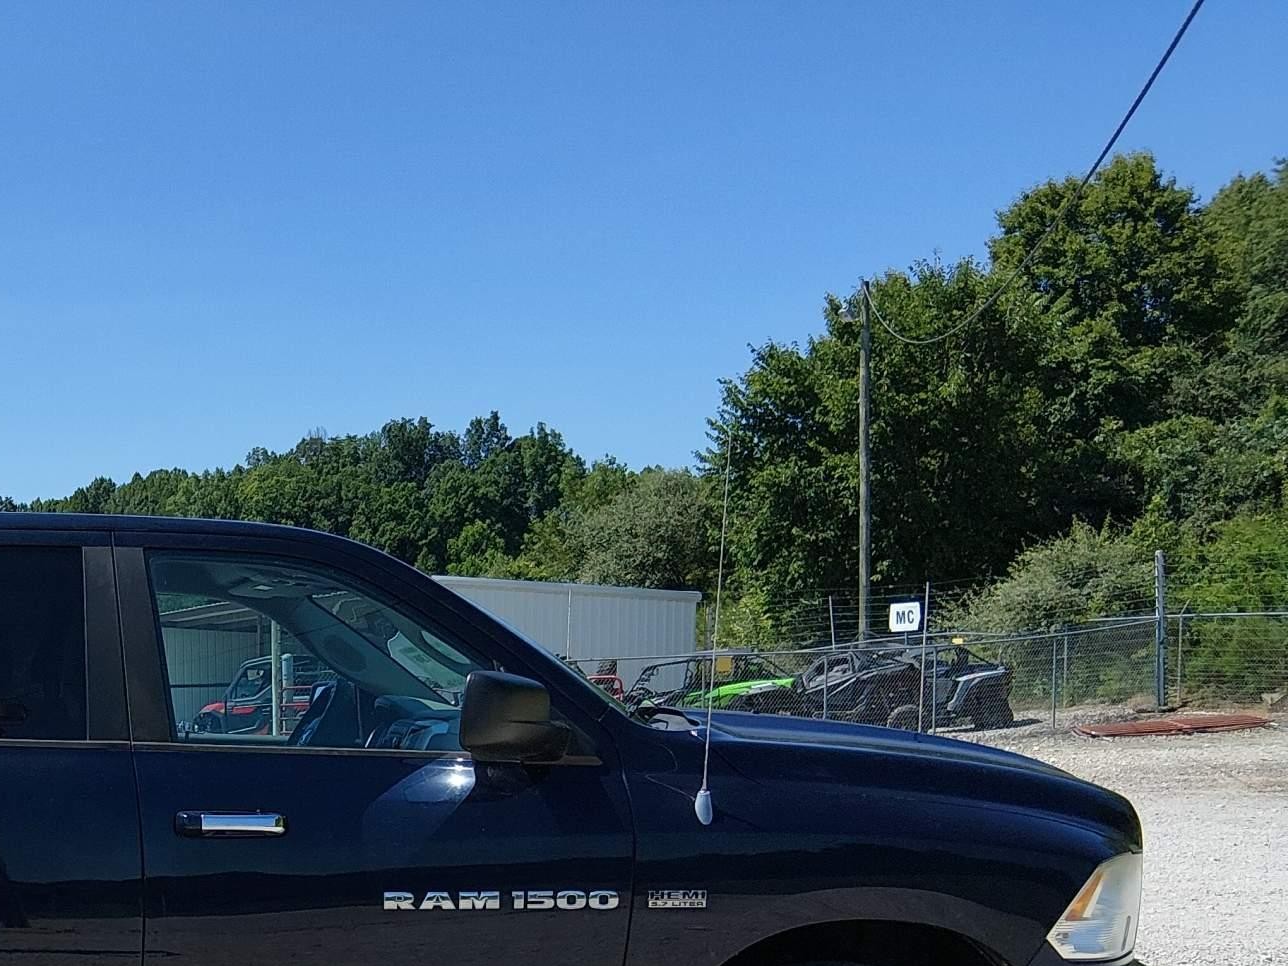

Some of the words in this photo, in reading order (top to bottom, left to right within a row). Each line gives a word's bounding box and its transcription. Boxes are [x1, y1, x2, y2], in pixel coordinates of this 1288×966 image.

[896, 609, 914, 625] MC
[383, 891, 500, 910] RAM
[511, 890, 619, 910] 1500
[647, 889, 707, 901] HEMI
